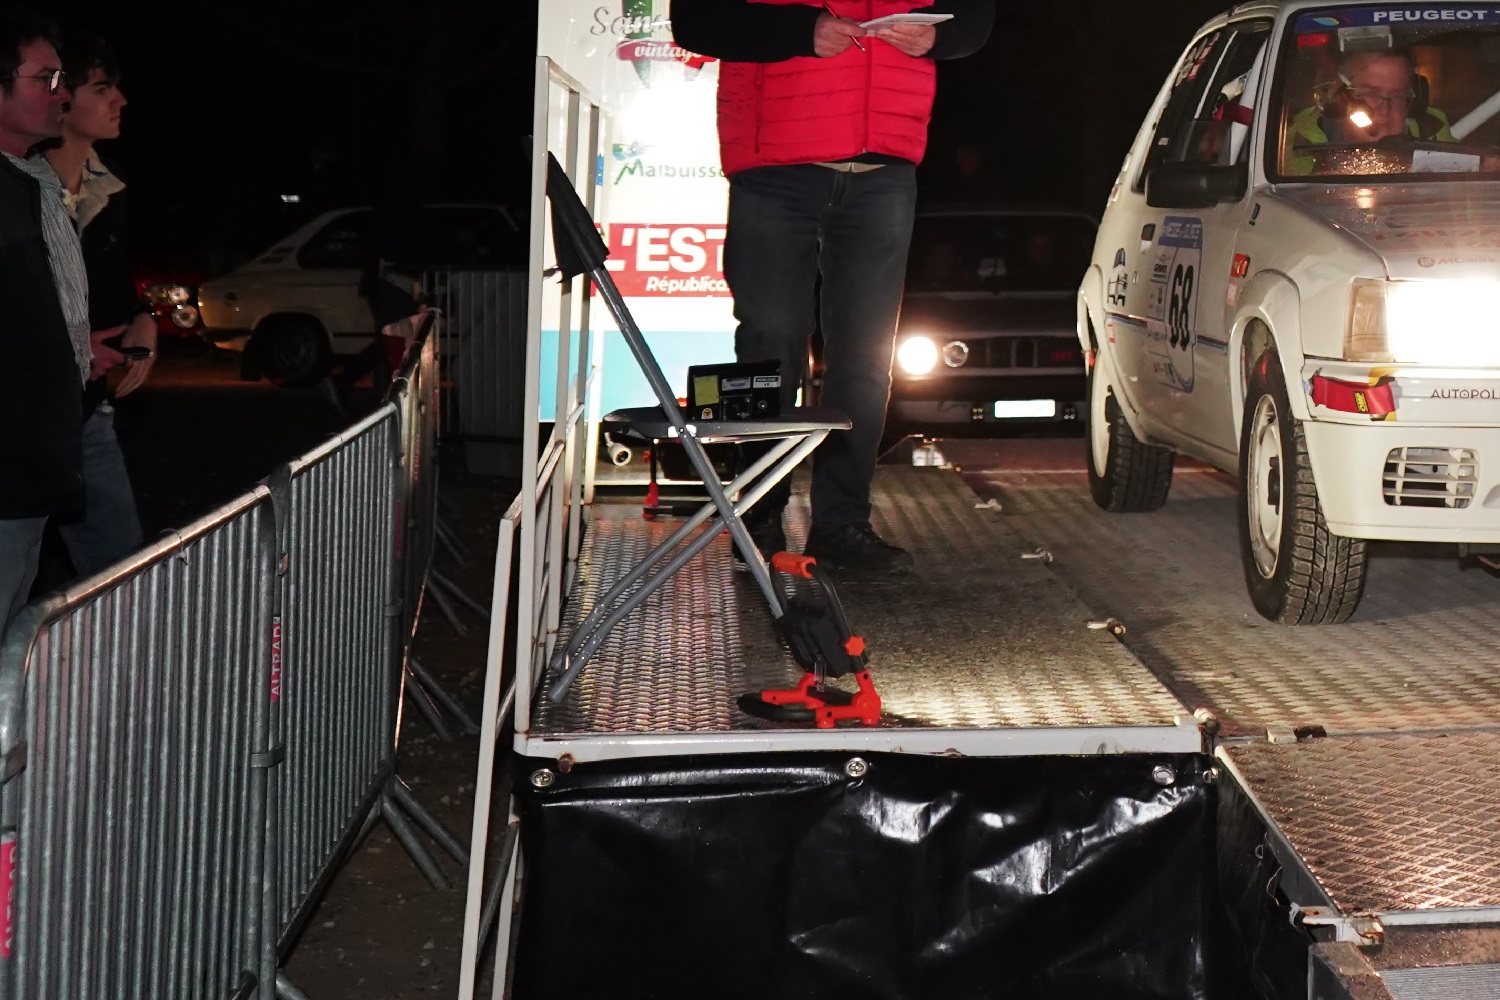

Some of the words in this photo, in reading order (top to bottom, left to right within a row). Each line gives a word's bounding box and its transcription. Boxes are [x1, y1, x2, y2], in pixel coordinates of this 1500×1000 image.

[1373, 10, 1488, 23] PEUGEOT
[634, 43, 704, 62] vintage
[614, 158, 727, 185] Malbuisso
[646, 276, 730, 294] Républica
[1169, 263, 1194, 351] 68
